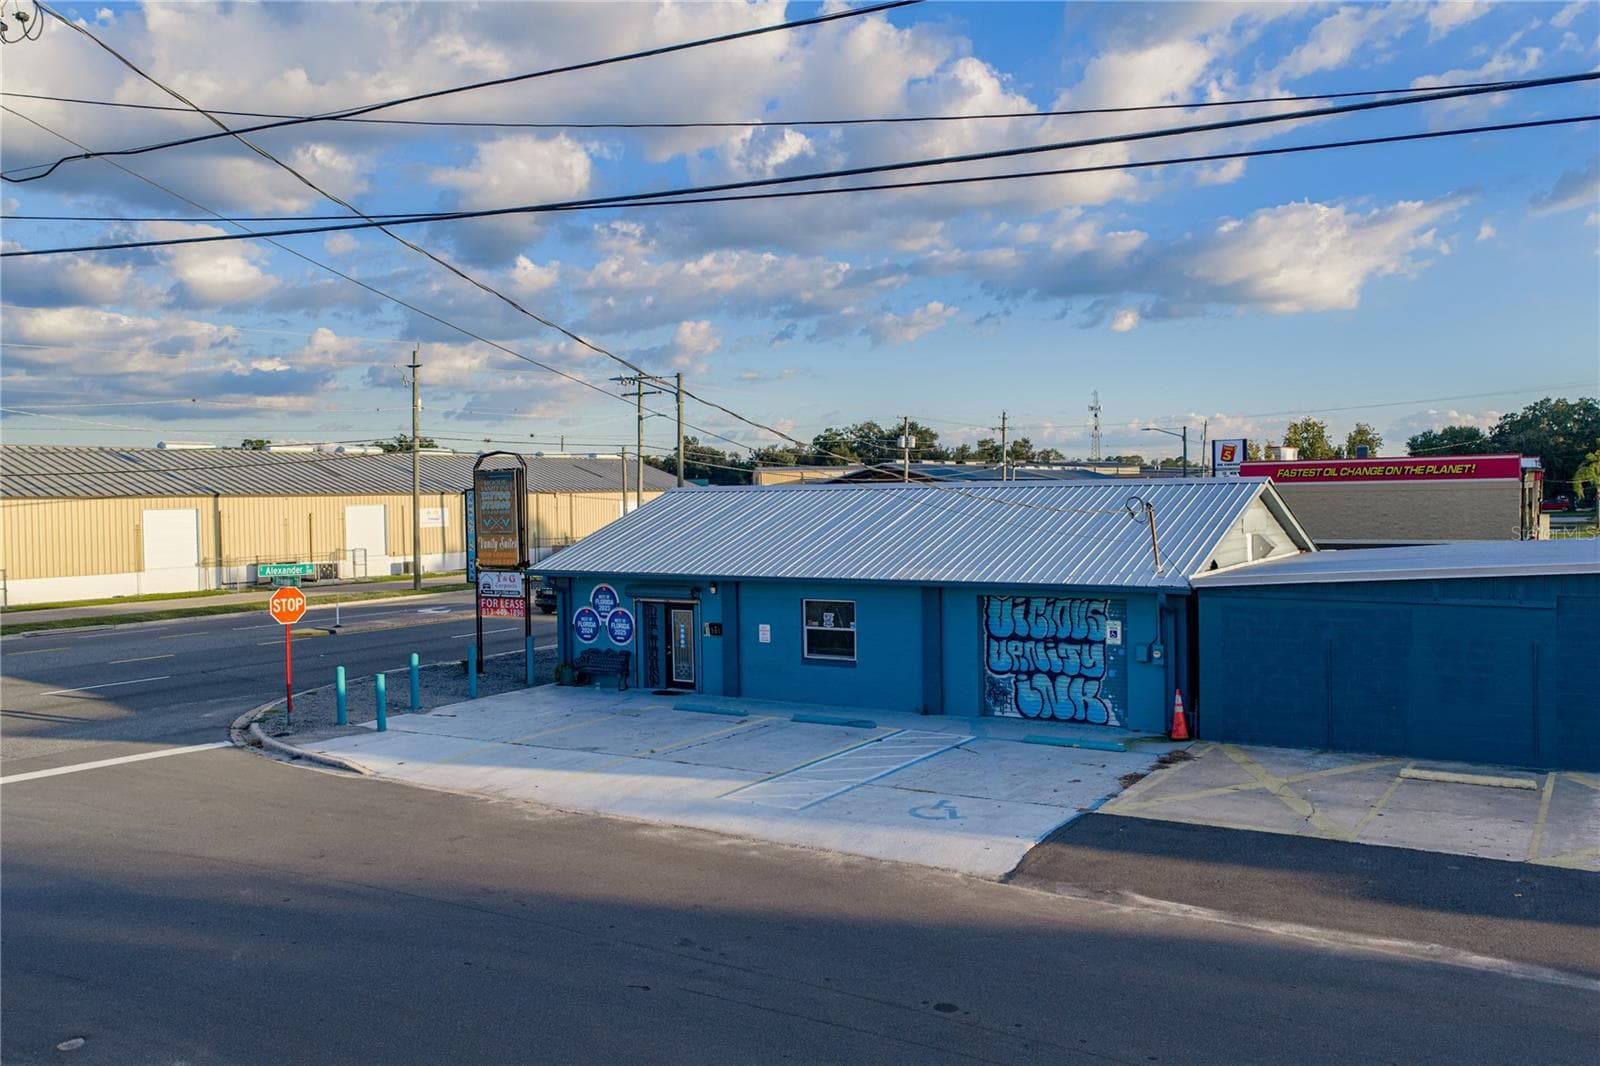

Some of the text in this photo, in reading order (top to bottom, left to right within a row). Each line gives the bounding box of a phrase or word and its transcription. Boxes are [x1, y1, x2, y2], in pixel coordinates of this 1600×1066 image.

[1222, 450, 1232, 460] 5
[1277, 468, 1321, 478] FASTEST
[1323, 467, 1338, 476] OIL
[1340, 466, 1384, 476] CHANGE
[1385, 466, 1402, 475] ON
[1403, 465, 1426, 475] THE
[265, 566, 303, 575] Alexander
[273, 598, 303, 613] STOP
[481, 599, 524, 609] FOR LEASE
[610, 622, 630, 630] FLORIDA
